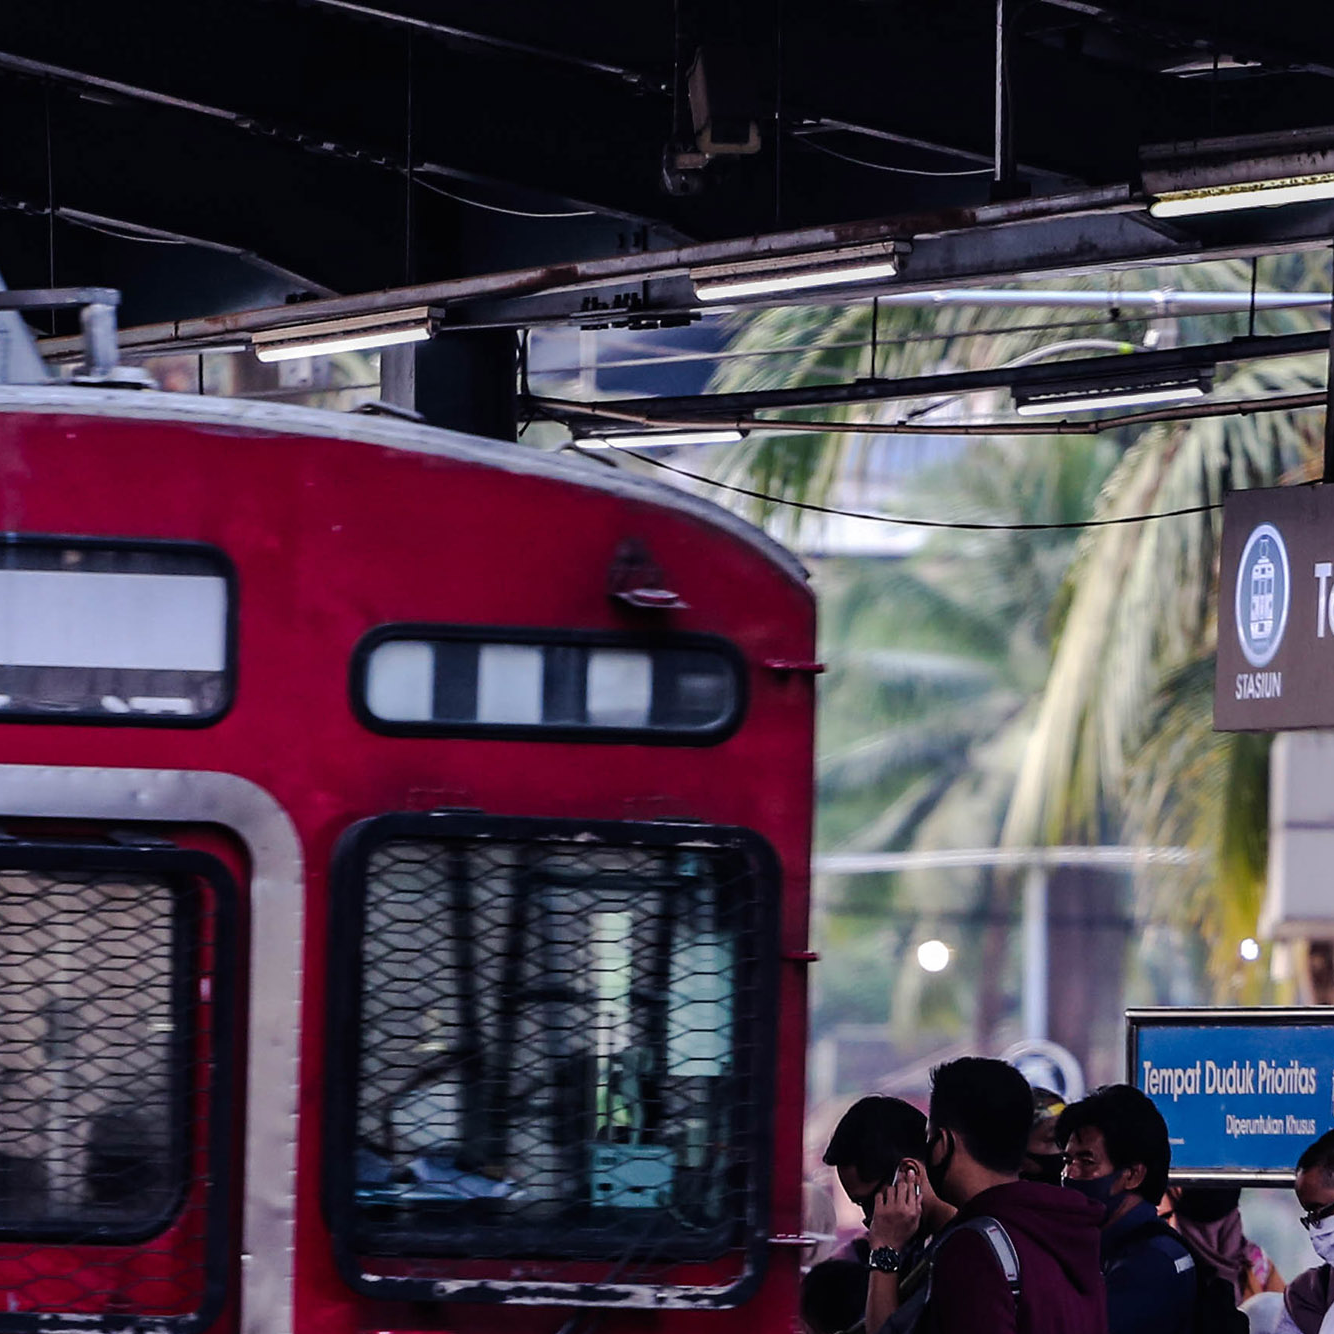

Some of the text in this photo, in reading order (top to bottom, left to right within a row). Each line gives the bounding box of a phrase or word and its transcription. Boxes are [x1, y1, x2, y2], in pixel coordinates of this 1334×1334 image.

[1235, 671, 1281, 699] STASIUN
[1143, 1060, 1316, 1102] Tempat Duduk Prioritas
[1286, 1114, 1316, 1134] Khusus
